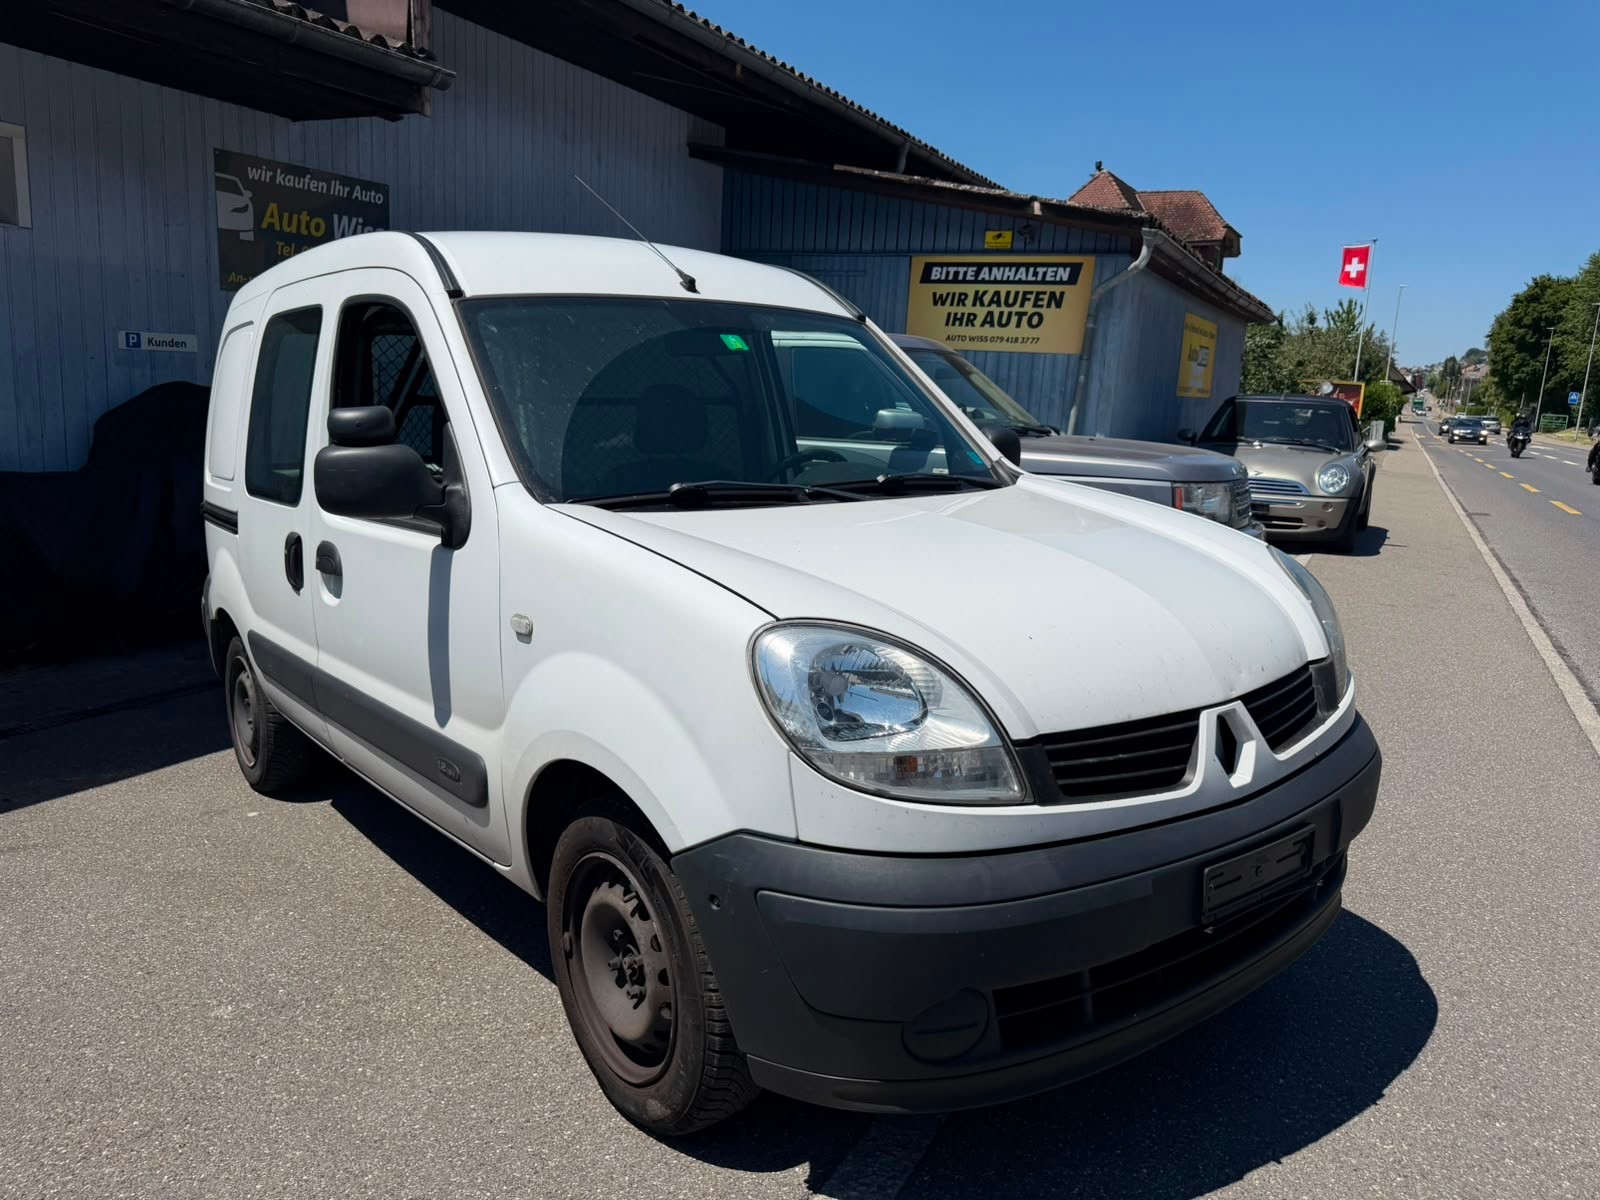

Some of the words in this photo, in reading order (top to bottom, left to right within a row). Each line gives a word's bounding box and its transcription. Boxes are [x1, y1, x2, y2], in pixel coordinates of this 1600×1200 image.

[247, 166, 274, 183] wir
[276, 168, 327, 194] kaufen
[330, 180, 350, 198] Ihr
[352, 185, 384, 205] Auto
[261, 202, 326, 238] Auto
[930, 266, 977, 281] BITTE
[977, 267, 1072, 282] ANHALTEN
[932, 292, 969, 307] WIR
[971, 290, 1066, 309] KAUFEN
[944, 312, 977, 327] IHR
[980, 311, 1045, 329] AUTO
[129, 334, 138, 347] P
[147, 337, 187, 349] Kunden
[945, 335, 967, 343] AUTO
[968, 335, 989, 343] WISS
[989, 335, 1005, 343] 079
[1005, 336, 1019, 344] 418
